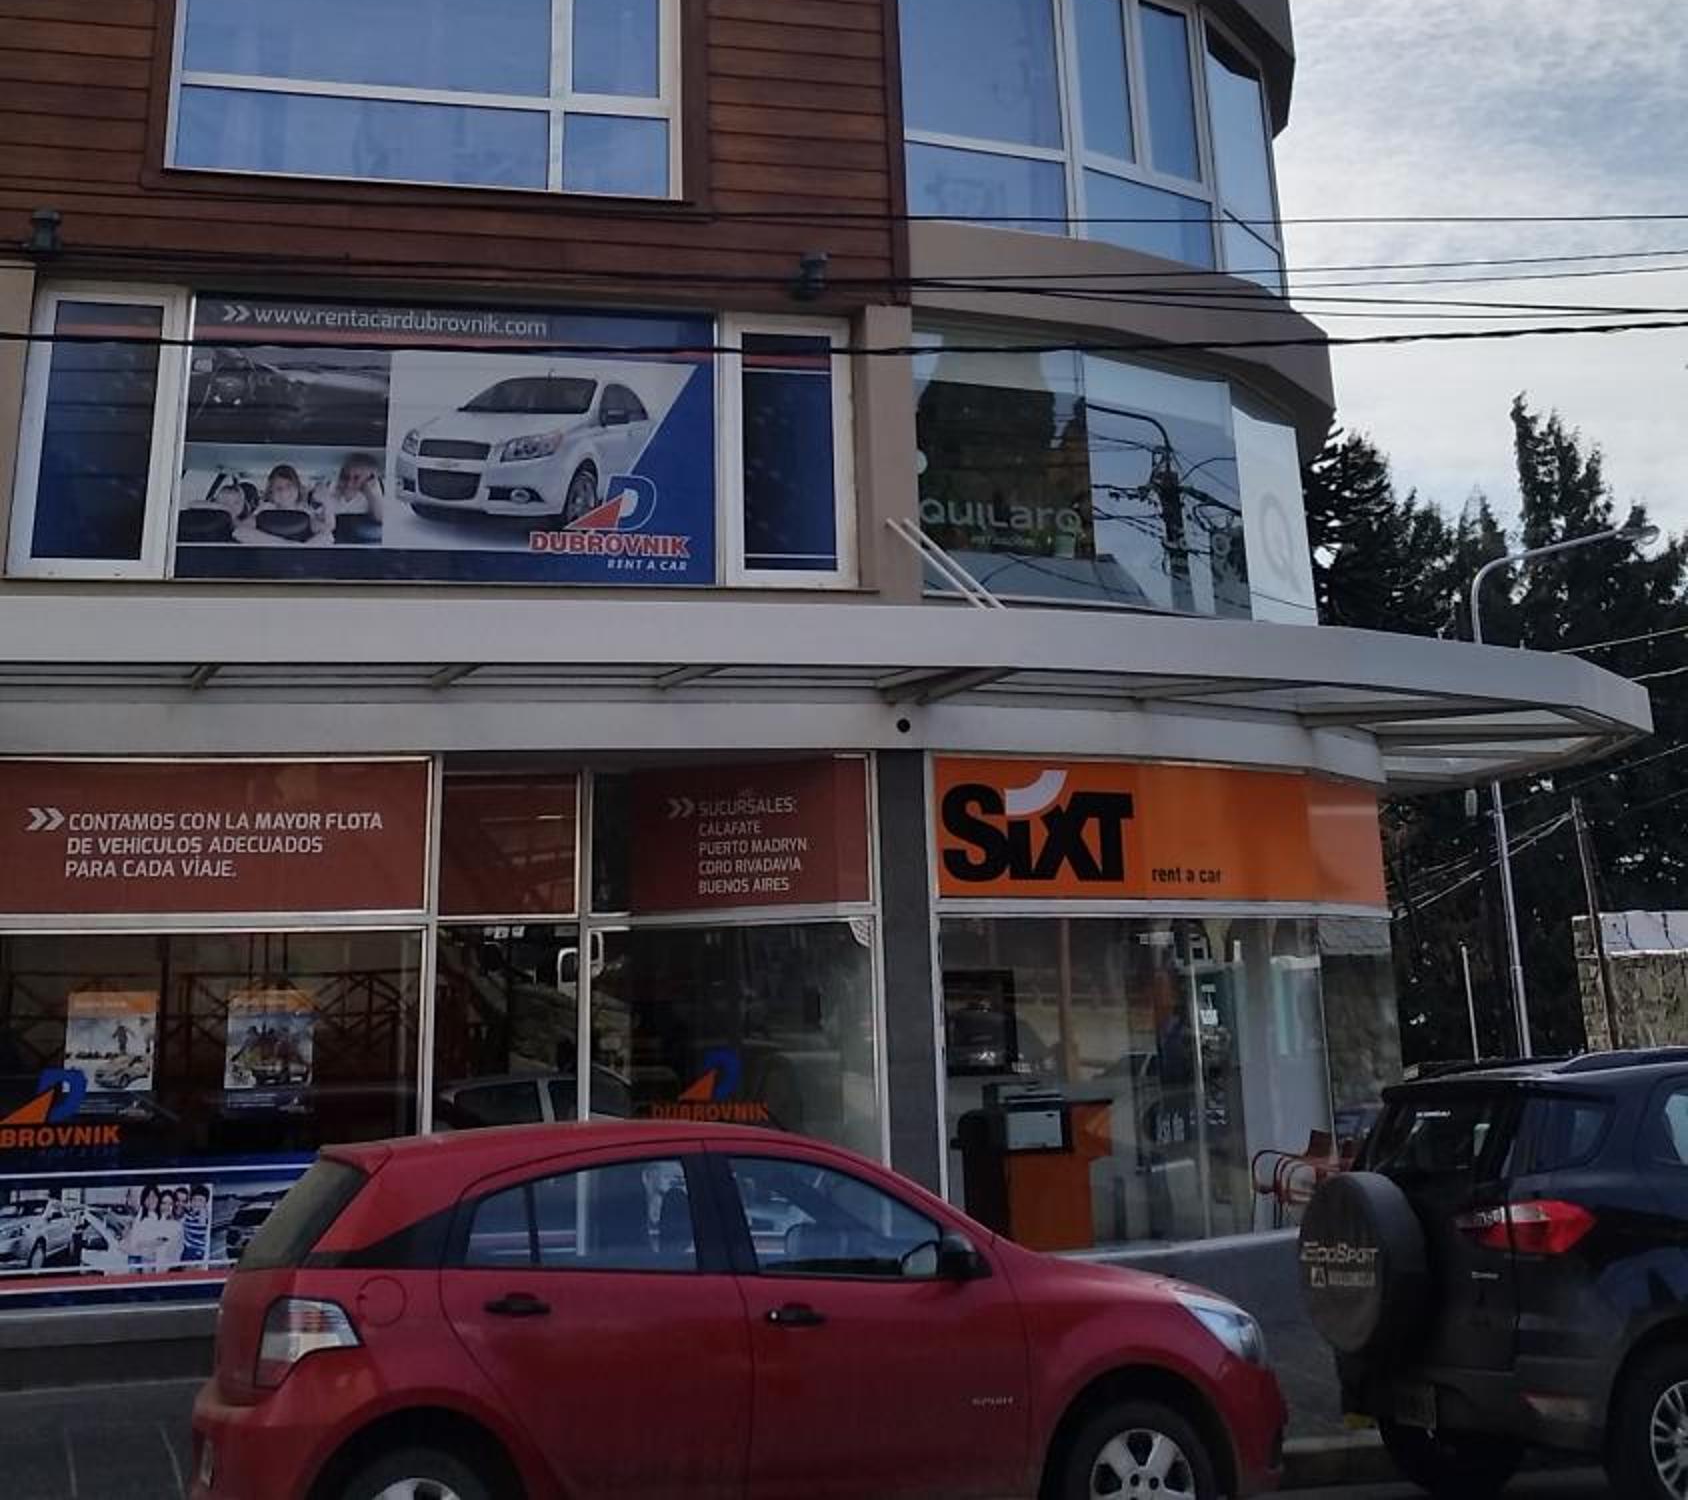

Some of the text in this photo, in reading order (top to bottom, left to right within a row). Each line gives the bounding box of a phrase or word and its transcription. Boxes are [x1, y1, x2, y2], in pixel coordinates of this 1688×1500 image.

[255, 304, 547, 336] www.rentacardubrovnik.com
[529, 531, 692, 558] DUBROVNIK
[607, 559, 688, 571] RENT A CAR
[68, 812, 383, 832] CONTAMOS CON LA MAYOR FLOTA
[698, 819, 761, 837] CALAFATE
[66, 836, 92, 855] DE
[208, 835, 323, 854] ADECUADOS
[698, 839, 749, 855] PUERTO
[64, 859, 117, 878] PARA
[122, 859, 175, 877] CADA
[735, 855, 802, 874] RIVADAVIA
[1152, 866, 1221, 883] rent a car
[699, 876, 790, 894] BUENOS AIRES
